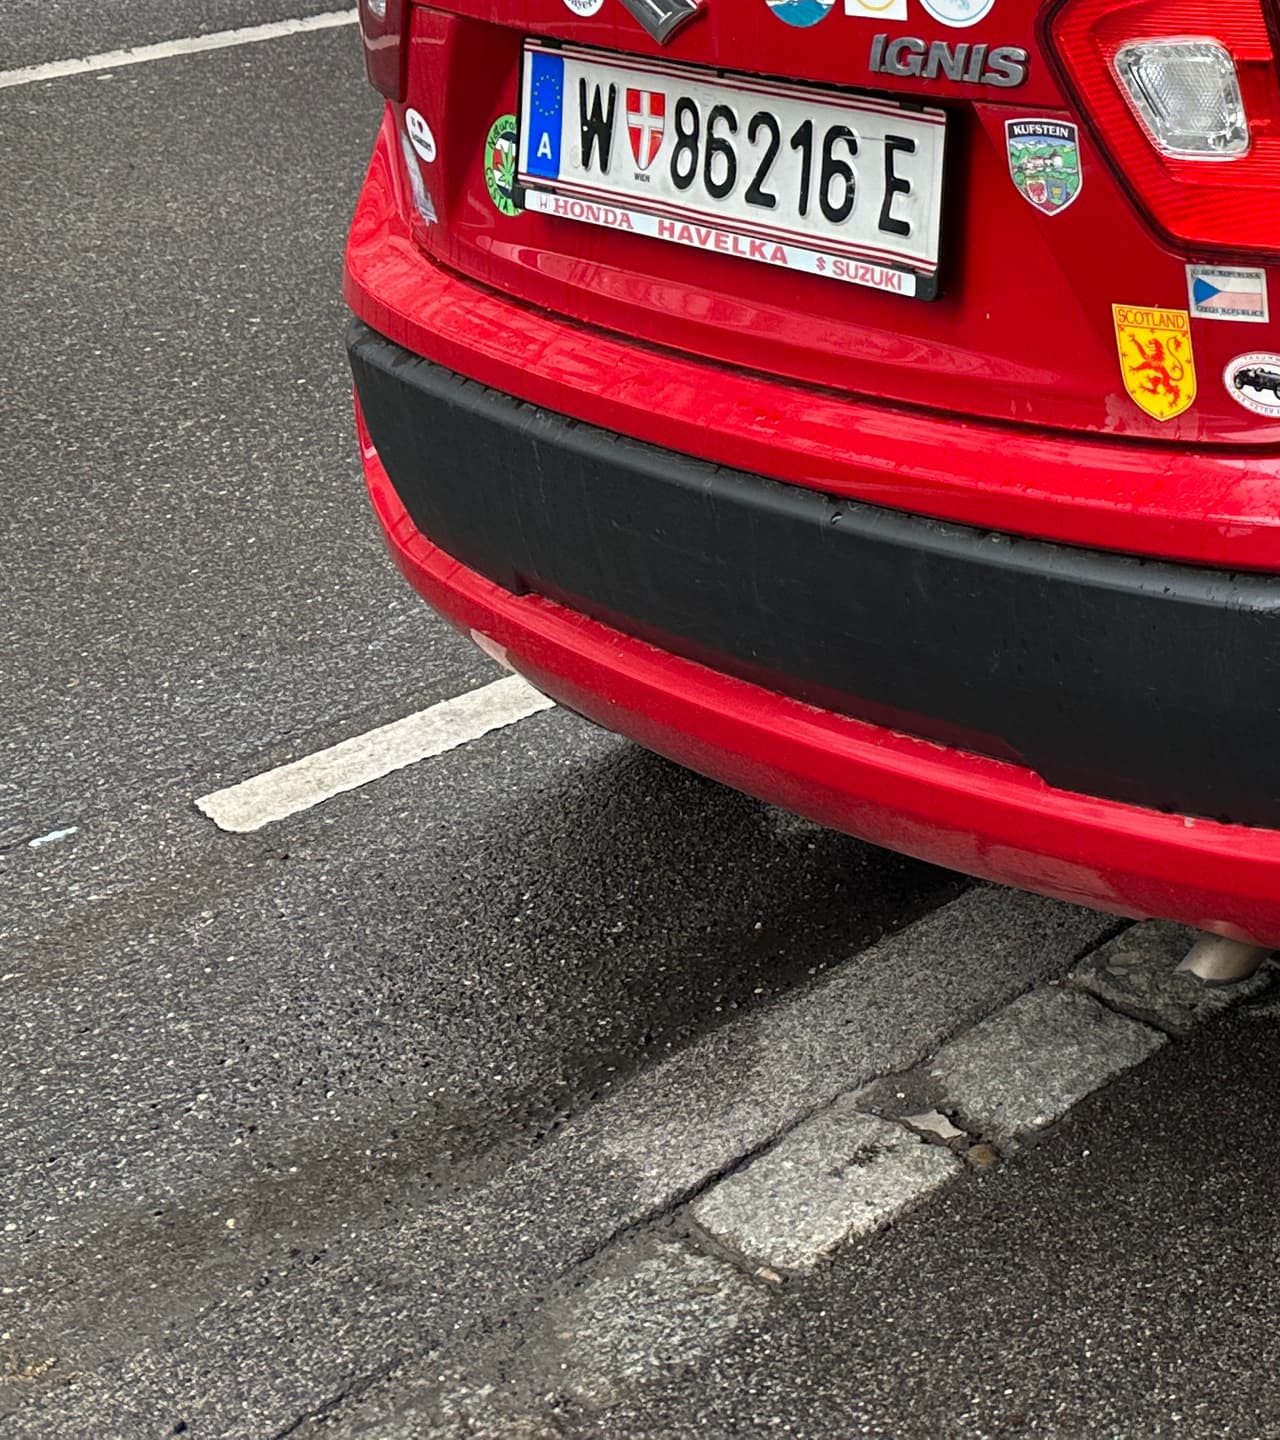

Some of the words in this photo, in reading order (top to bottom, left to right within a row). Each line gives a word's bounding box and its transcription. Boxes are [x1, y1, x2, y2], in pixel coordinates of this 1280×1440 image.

[869, 33, 1029, 88] IGNIS
[1013, 124, 1069, 138] KUFSTEIN
[536, 132, 553, 160] A
[579, 77, 617, 174] W
[670, 96, 860, 225] 86216
[878, 133, 916, 237] E
[633, 172, 651, 183] WIEN
[552, 198, 634, 231] HONDA
[658, 220, 788, 264] HAVELKA
[832, 260, 902, 291] SUZUKI
[1118, 309, 1186, 330] SCOTLAND
